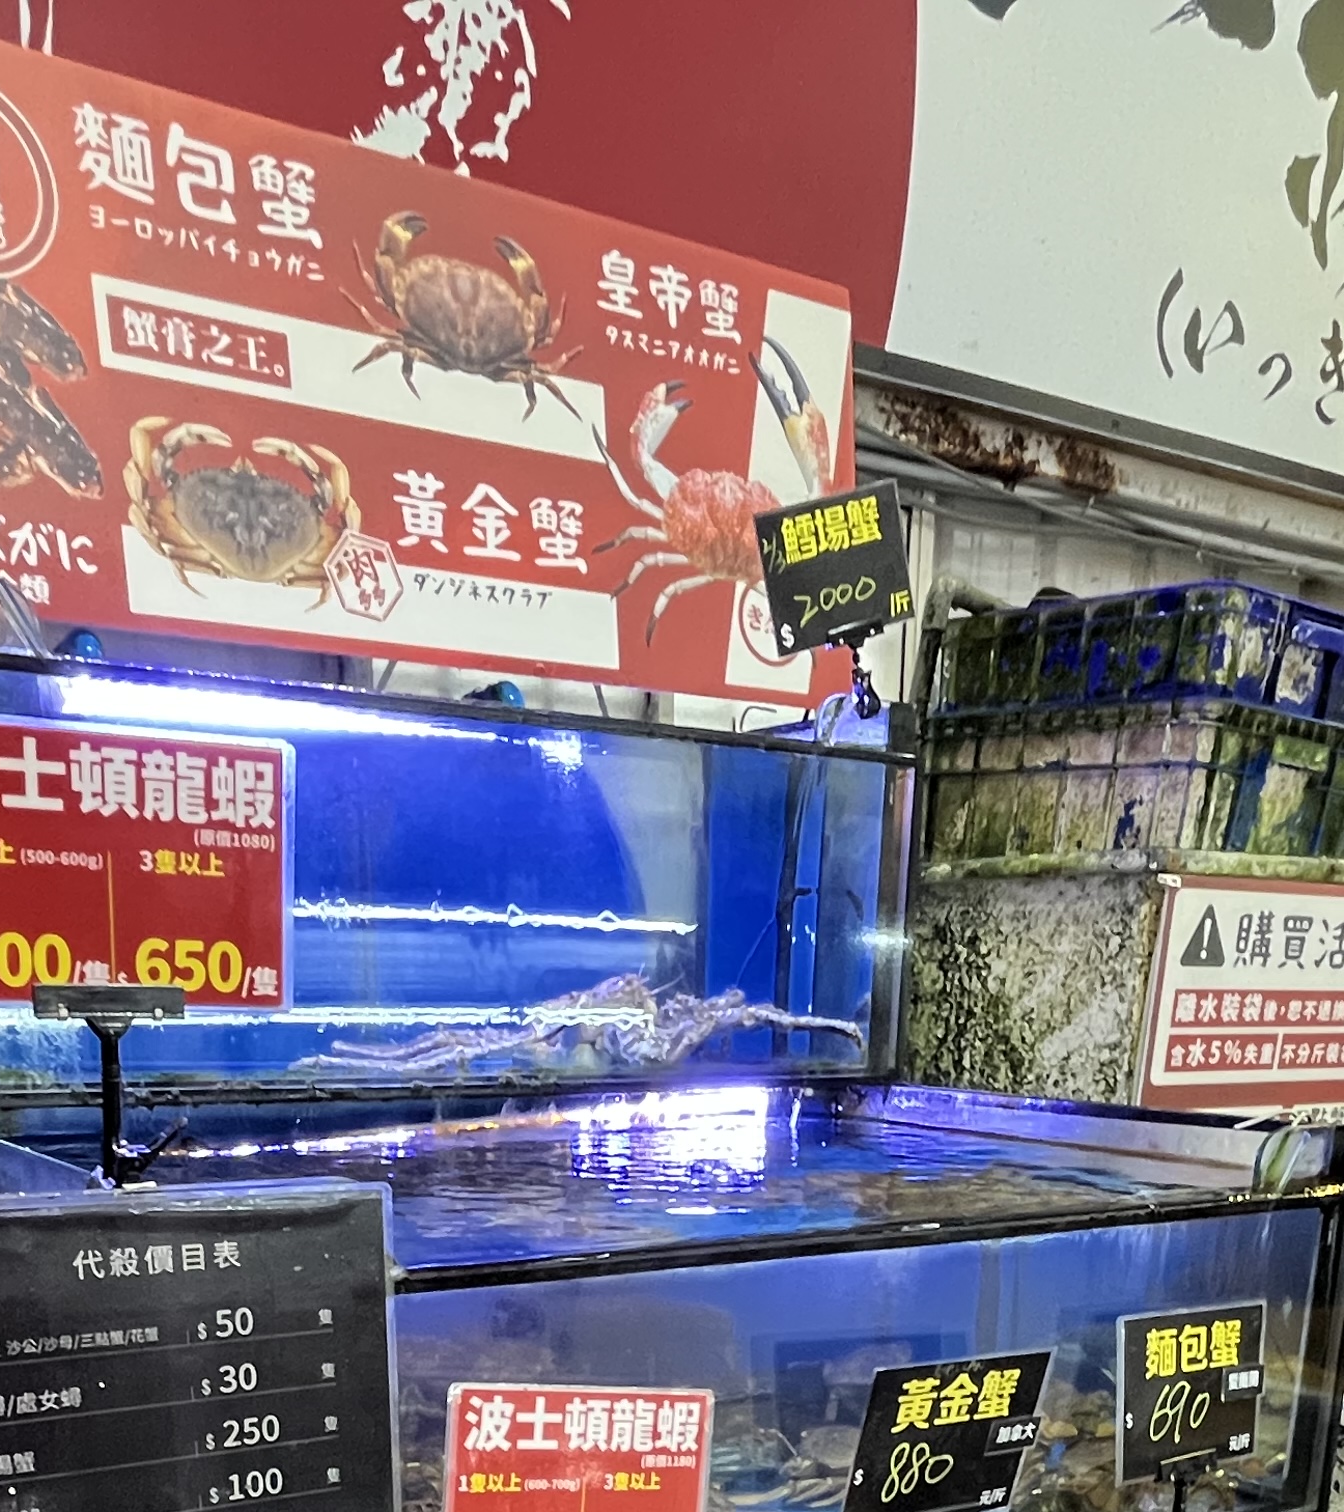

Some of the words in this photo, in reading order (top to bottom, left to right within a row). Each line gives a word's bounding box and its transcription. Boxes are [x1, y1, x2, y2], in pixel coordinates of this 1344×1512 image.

[72, 102, 323, 250] 麵包蟹
[597, 249, 742, 345] 皇帝蟹
[393, 469, 588, 575] 黃金蟹
[793, 575, 877, 629] 2000
[780, 622, 796, 650] $
[72, 1240, 243, 1281] 代殺價目表
[197, 1322, 208, 1340] $
[215, 1307, 254, 1338] 50
[1145, 1319, 1242, 1380] 麵包蟹
[200, 1378, 212, 1396] $
[218, 1363, 258, 1394] 30
[890, 1368, 1022, 1434] 黃金蟹
[205, 1433, 216, 1450] $
[222, 1414, 281, 1448] 250
[463, 1395, 701, 1453] 波士頓龍蝦
[1125, 1412, 1134, 1429] $
[209, 1487, 220, 1504] $
[228, 1467, 284, 1501] 100
[853, 1468, 865, 1486] $
[880, 1441, 954, 1504] 880
